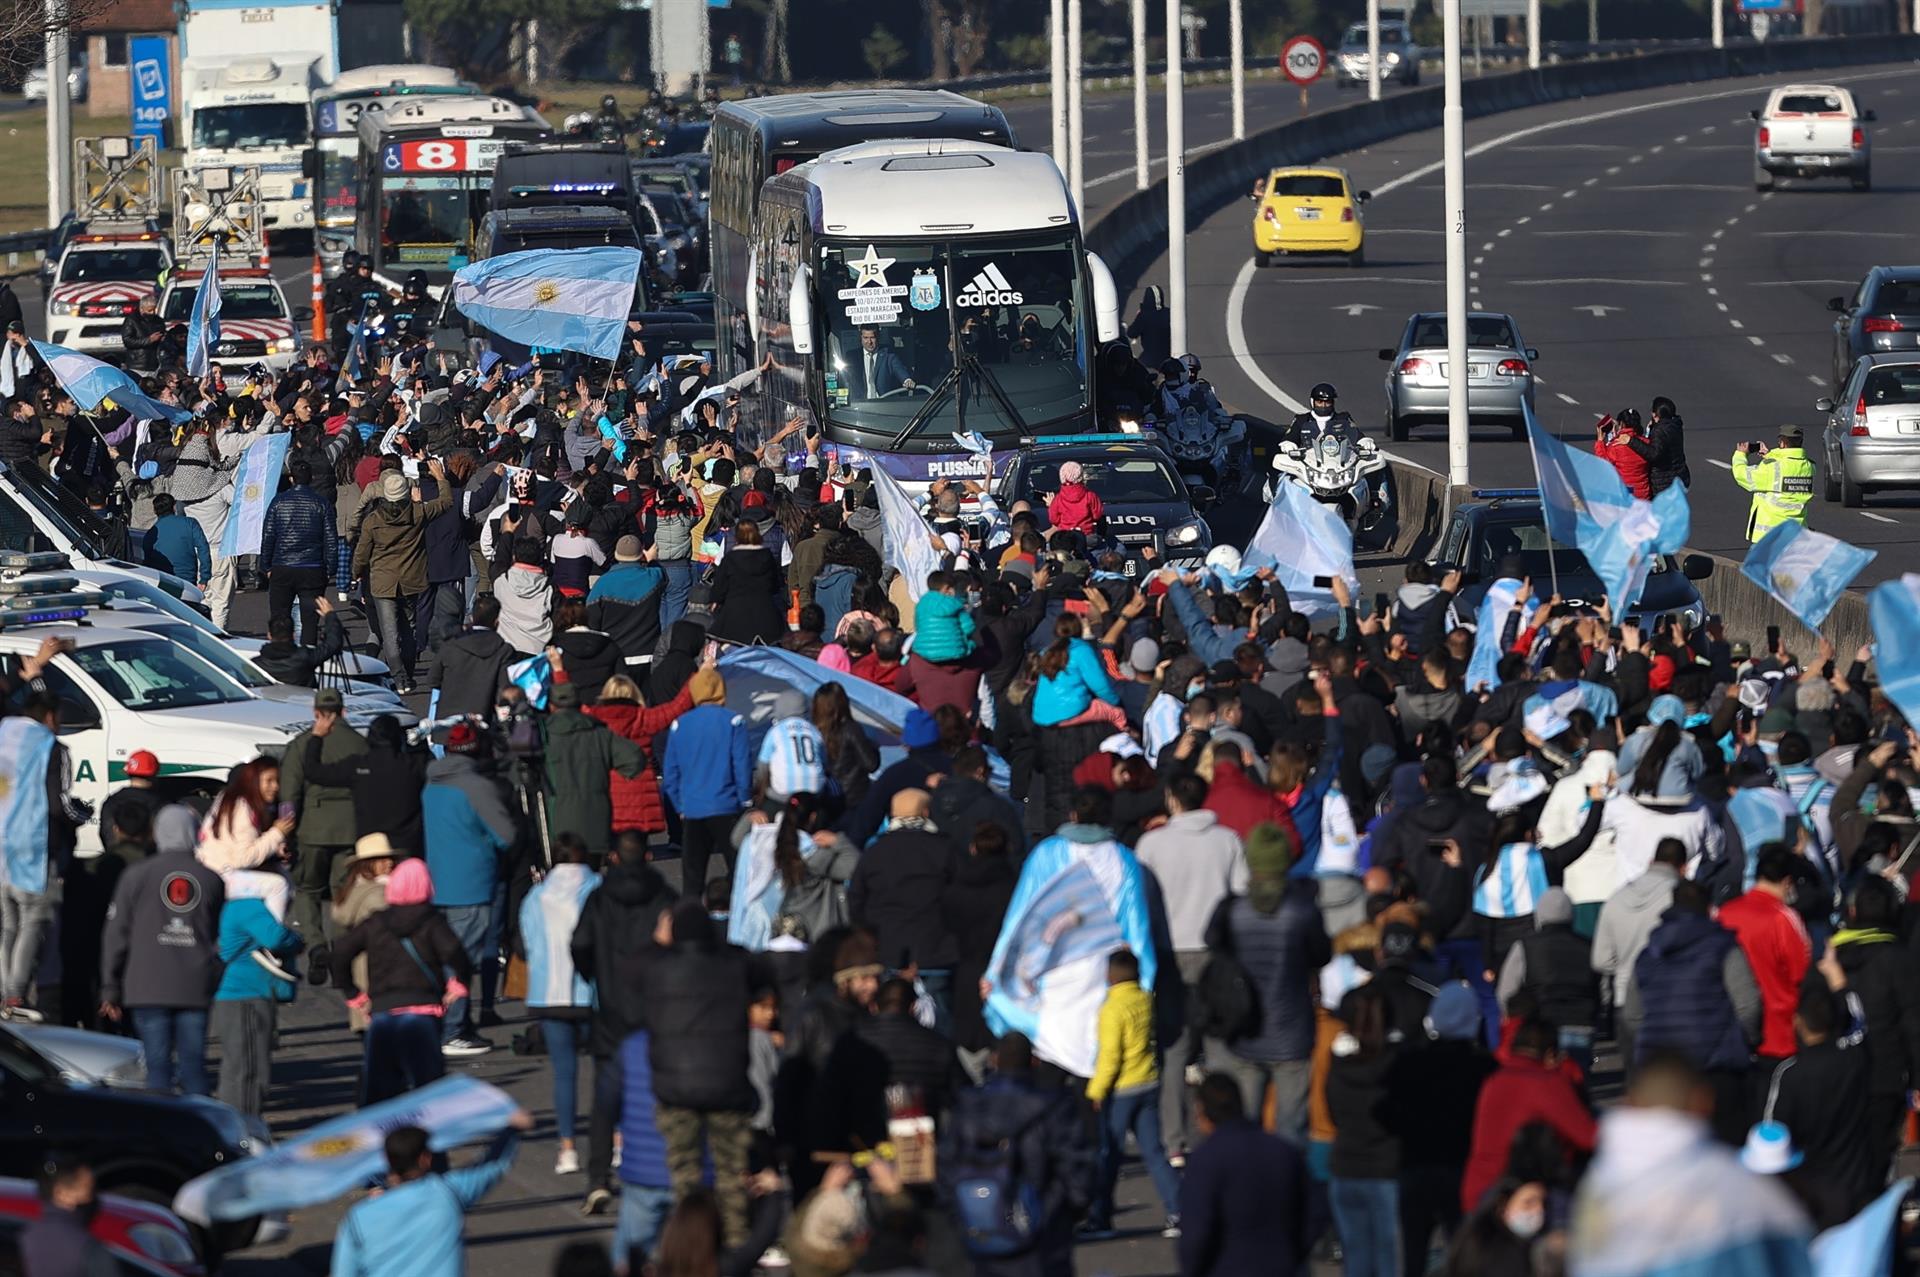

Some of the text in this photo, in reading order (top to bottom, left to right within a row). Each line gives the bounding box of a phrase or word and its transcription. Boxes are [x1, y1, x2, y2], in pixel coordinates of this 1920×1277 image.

[1288, 53, 1319, 67] 100
[136, 107, 167, 120] 140
[417, 142, 456, 169] 8
[862, 264, 879, 276] 15
[840, 286, 906, 299] CAMPEONES DE AMERICA
[957, 290, 1023, 307] adidas
[857, 297, 890, 305] 10/07/2021
[847, 306, 869, 315] ESTADIO
[853, 312, 896, 323] RIO DE JANEIRO
[790, 733, 815, 764] 10
